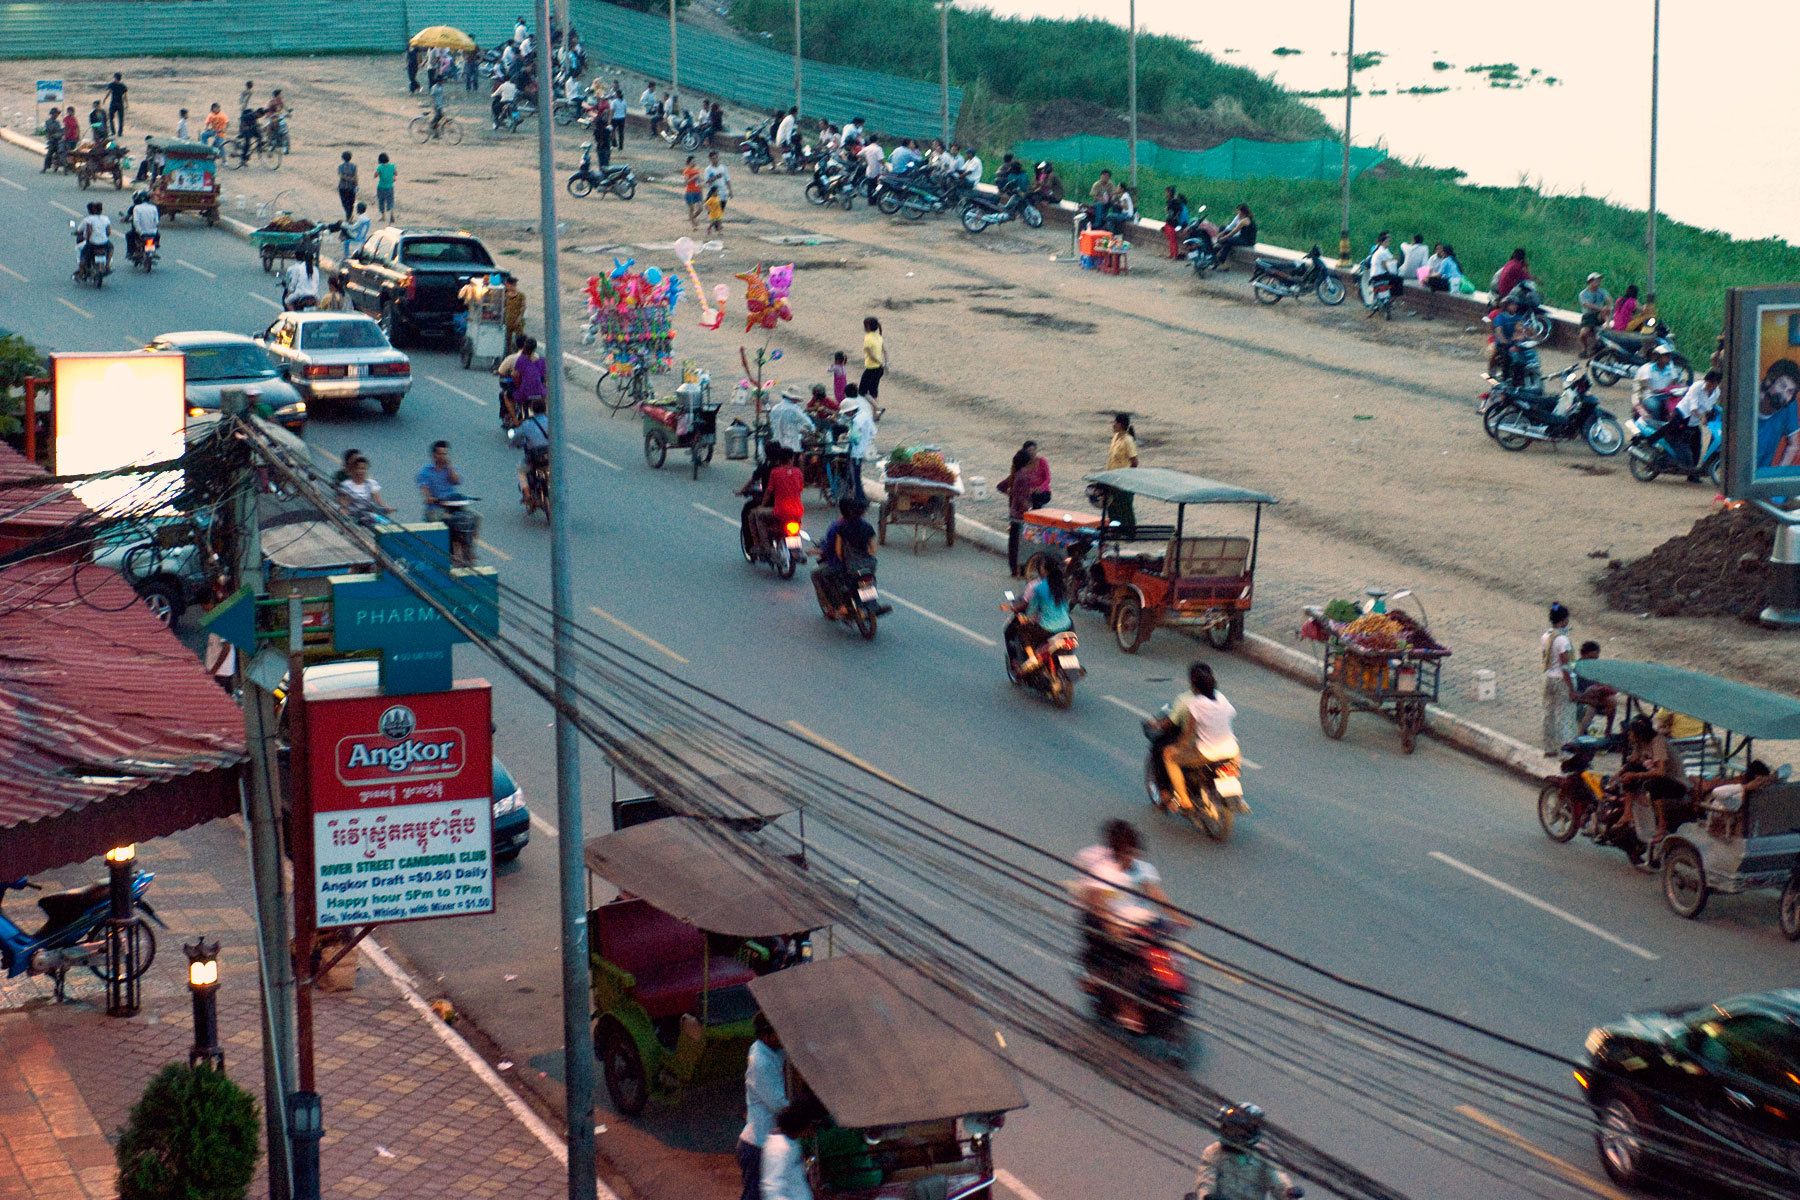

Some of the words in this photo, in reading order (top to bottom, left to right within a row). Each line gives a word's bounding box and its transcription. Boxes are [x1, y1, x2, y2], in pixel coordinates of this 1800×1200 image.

[355, 603, 481, 626] PHARMCY
[347, 739, 455, 772] Angkor
[320, 863, 353, 877] RIVER
[356, 859, 396, 873] STREET
[398, 852, 456, 869] CAMBODIA
[459, 849, 487, 863] CLUB
[321, 879, 368, 893] Angkor
[371, 874, 405, 888] Draft
[455, 866, 488, 880] Daily
[326, 896, 369, 909] Happy
[372, 893, 402, 904] hour
[404, 889, 433, 901] 5Pm
[437, 887, 451, 897] to
[453, 884, 483, 896] 7Pm
[409, 903, 429, 914] with
